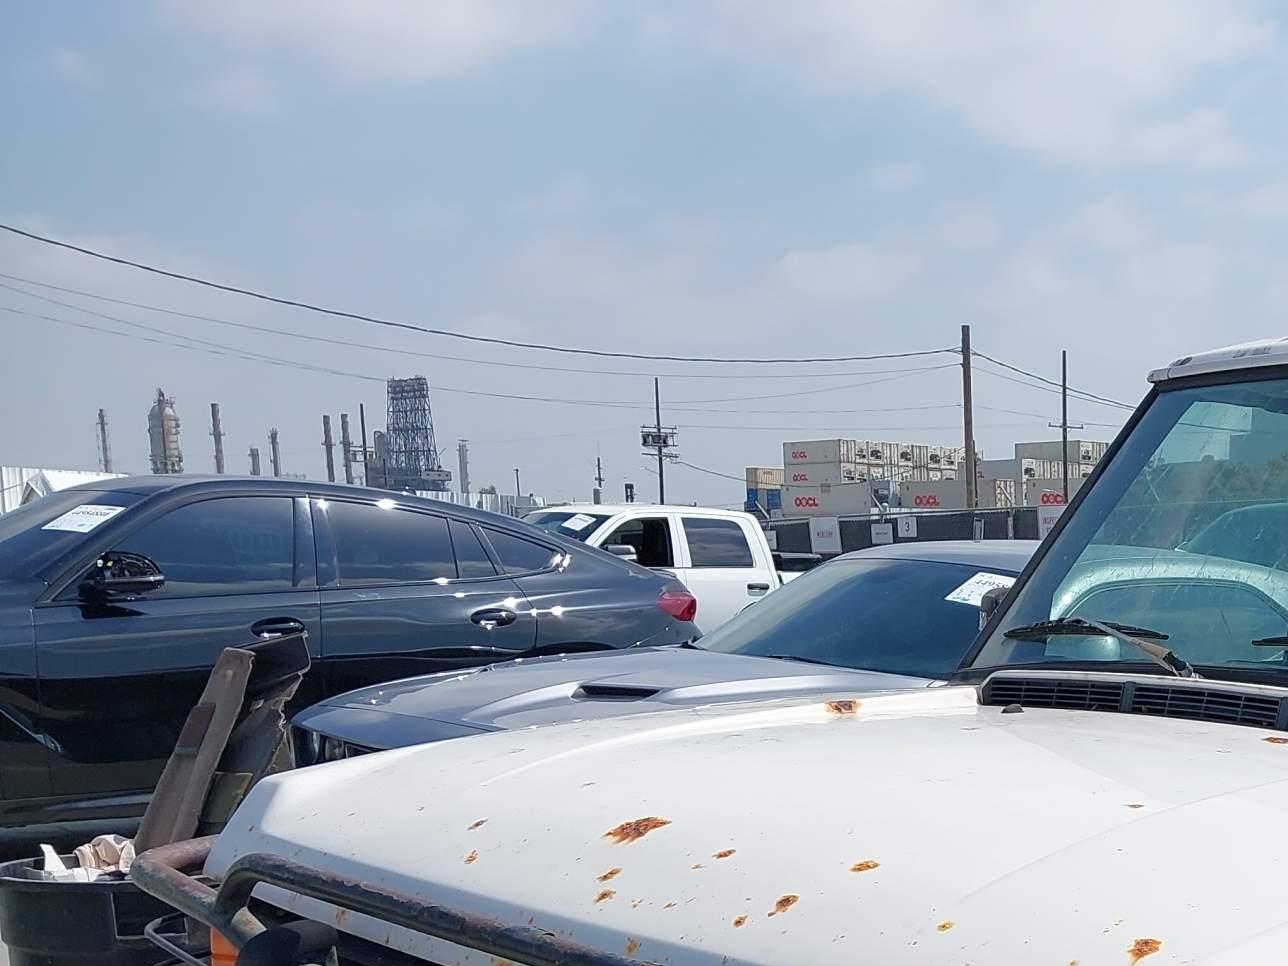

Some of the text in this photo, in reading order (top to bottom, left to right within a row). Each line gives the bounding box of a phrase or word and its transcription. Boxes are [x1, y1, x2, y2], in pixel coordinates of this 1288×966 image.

[795, 496, 818, 507] OOCL
[914, 494, 939, 507] OOCL
[905, 521, 911, 532] 3
